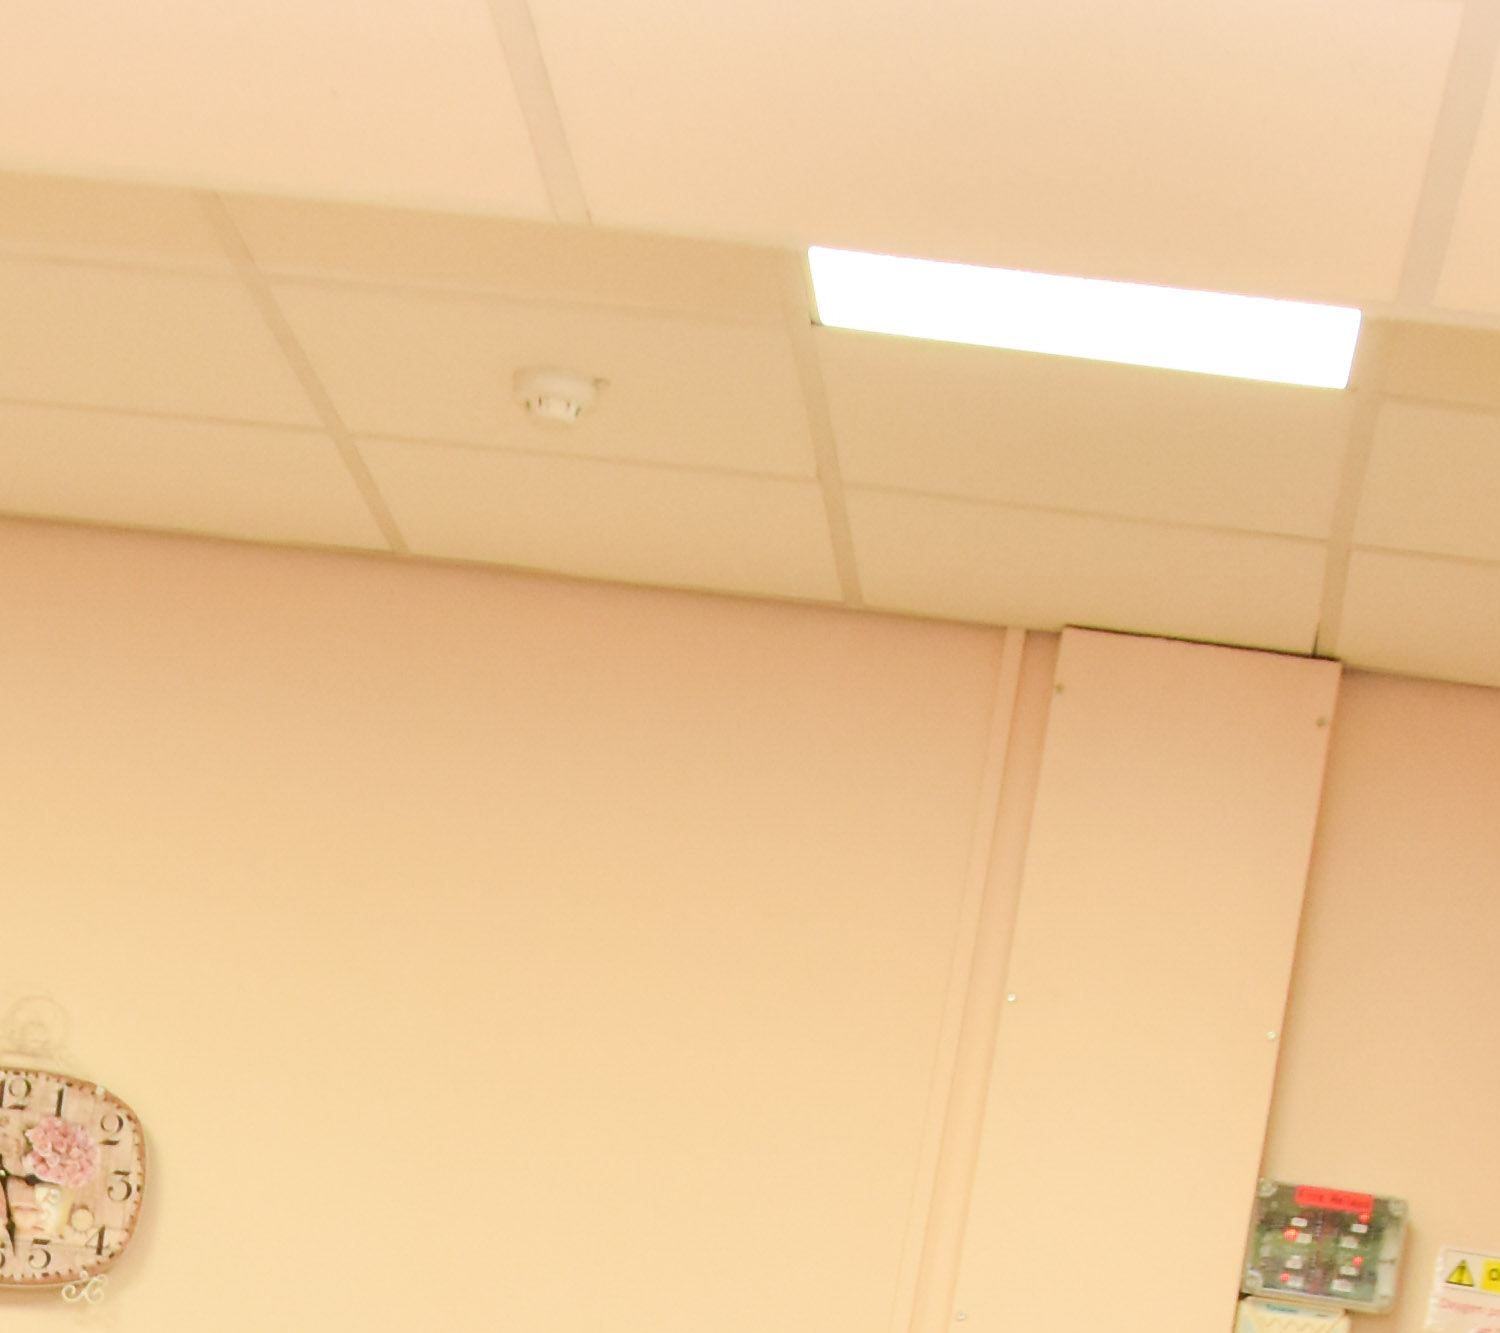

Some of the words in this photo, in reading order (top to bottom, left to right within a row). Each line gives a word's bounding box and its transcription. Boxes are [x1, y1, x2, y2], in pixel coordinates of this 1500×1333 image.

[53, 1087, 66, 1117] 1
[99, 1113, 124, 1146] 2
[107, 1170, 133, 1202] 3
[28, 1238, 52, 1270] 5
[85, 1225, 106, 1256] 4
